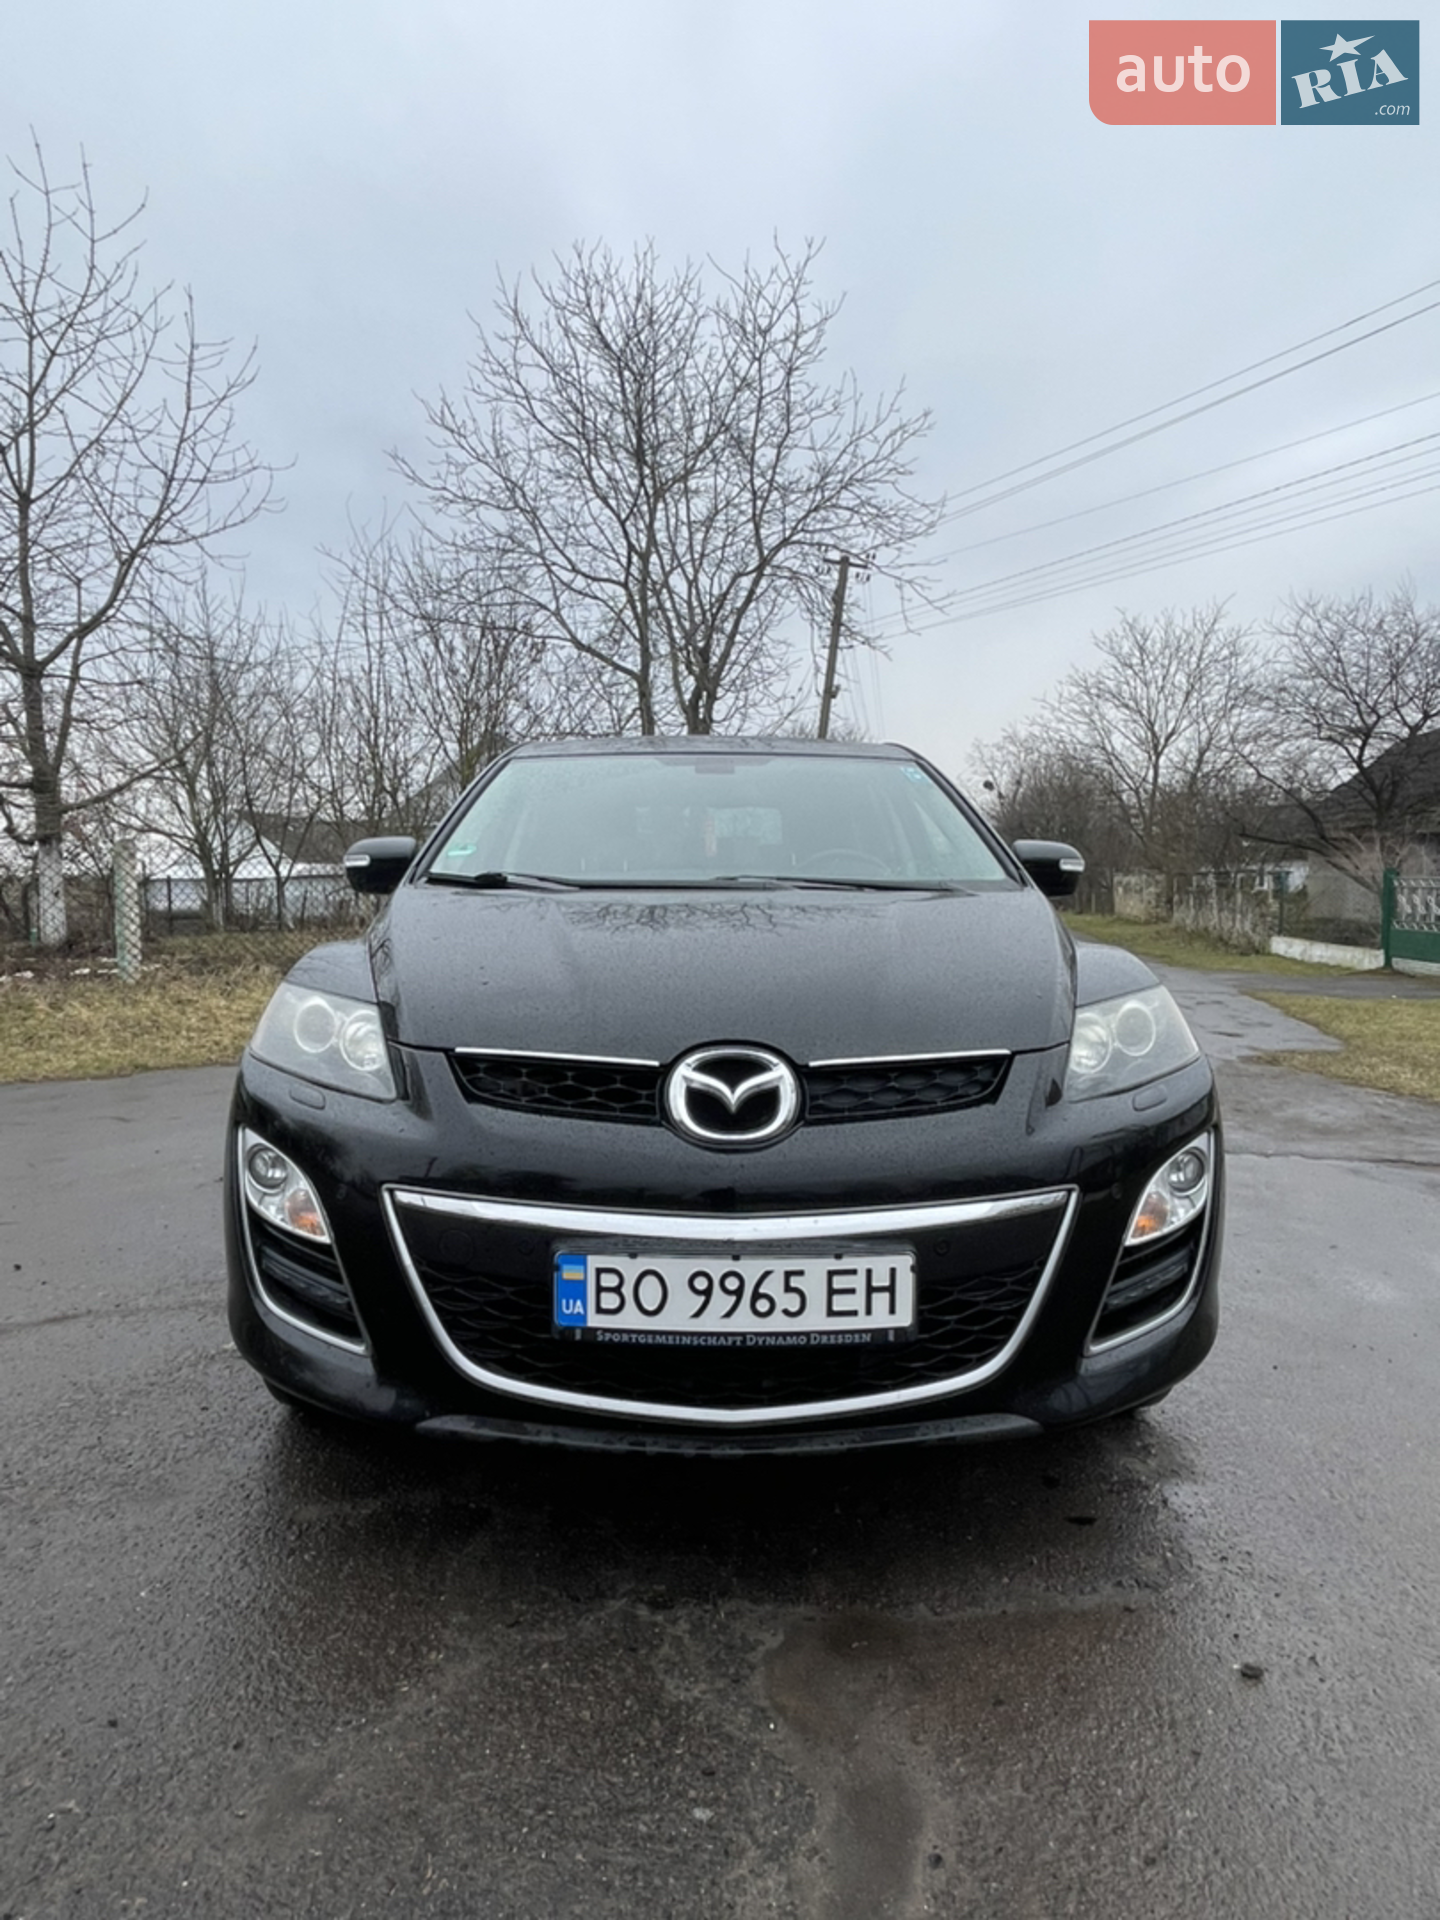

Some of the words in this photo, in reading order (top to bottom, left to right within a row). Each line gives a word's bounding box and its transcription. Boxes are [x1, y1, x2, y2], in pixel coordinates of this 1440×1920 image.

[595, 1267, 668, 1317] BO
[688, 1269, 807, 1319] 9965
[826, 1267, 897, 1317] EH
[561, 1299, 585, 1315] UA
[746, 1333, 807, 1346] DYNAMO
[810, 1333, 871, 1345] DRESDEN
